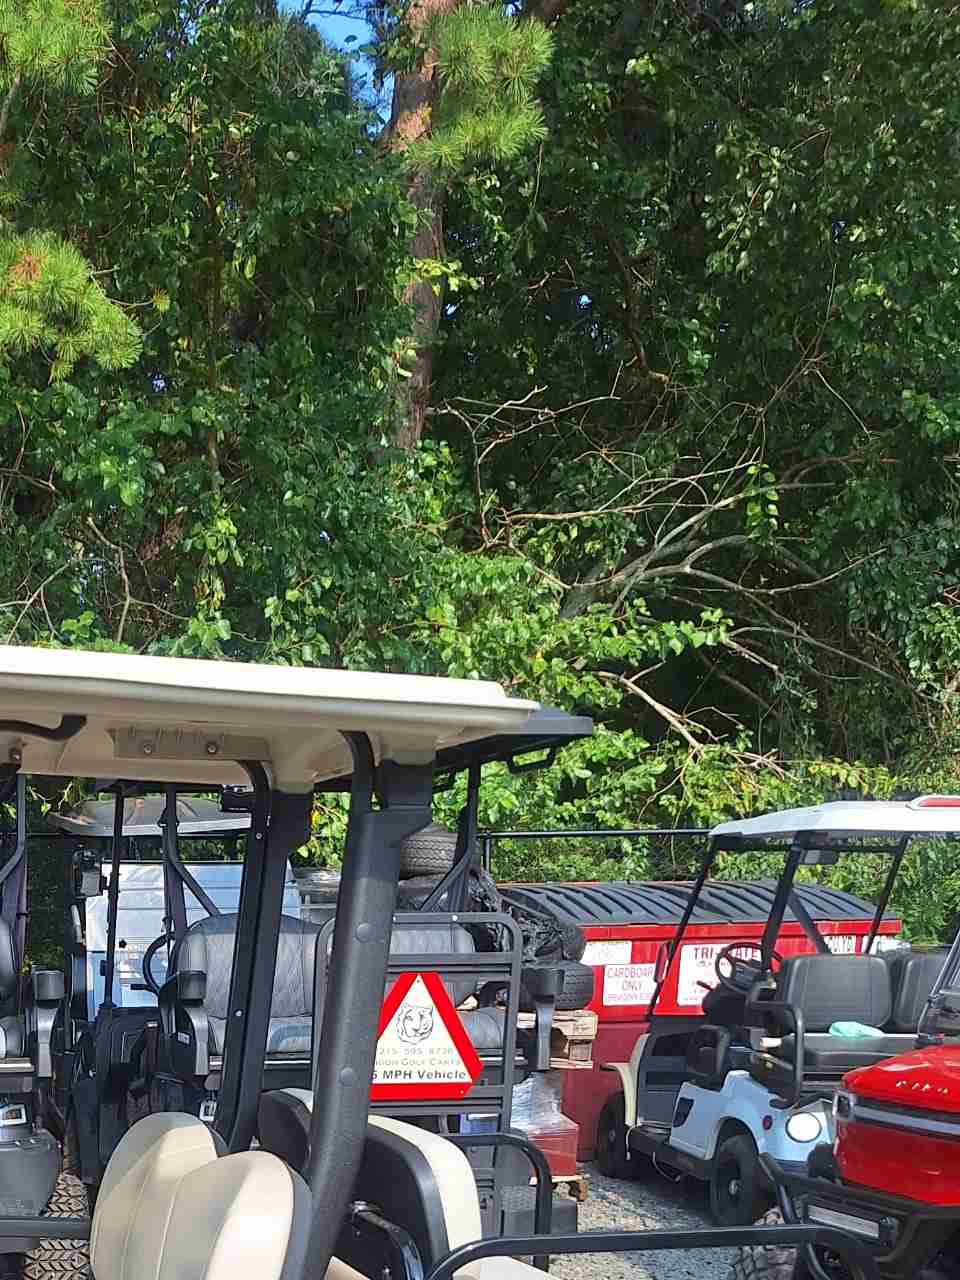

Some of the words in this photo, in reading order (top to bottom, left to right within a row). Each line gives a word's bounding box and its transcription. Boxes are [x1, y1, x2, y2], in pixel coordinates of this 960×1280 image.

[694, 946, 759, 960] TRI-ATE
[607, 966, 654, 978] CARDBOAR
[383, 1070, 412, 1080] MPH
[417, 1069, 466, 1080] Vehicle
